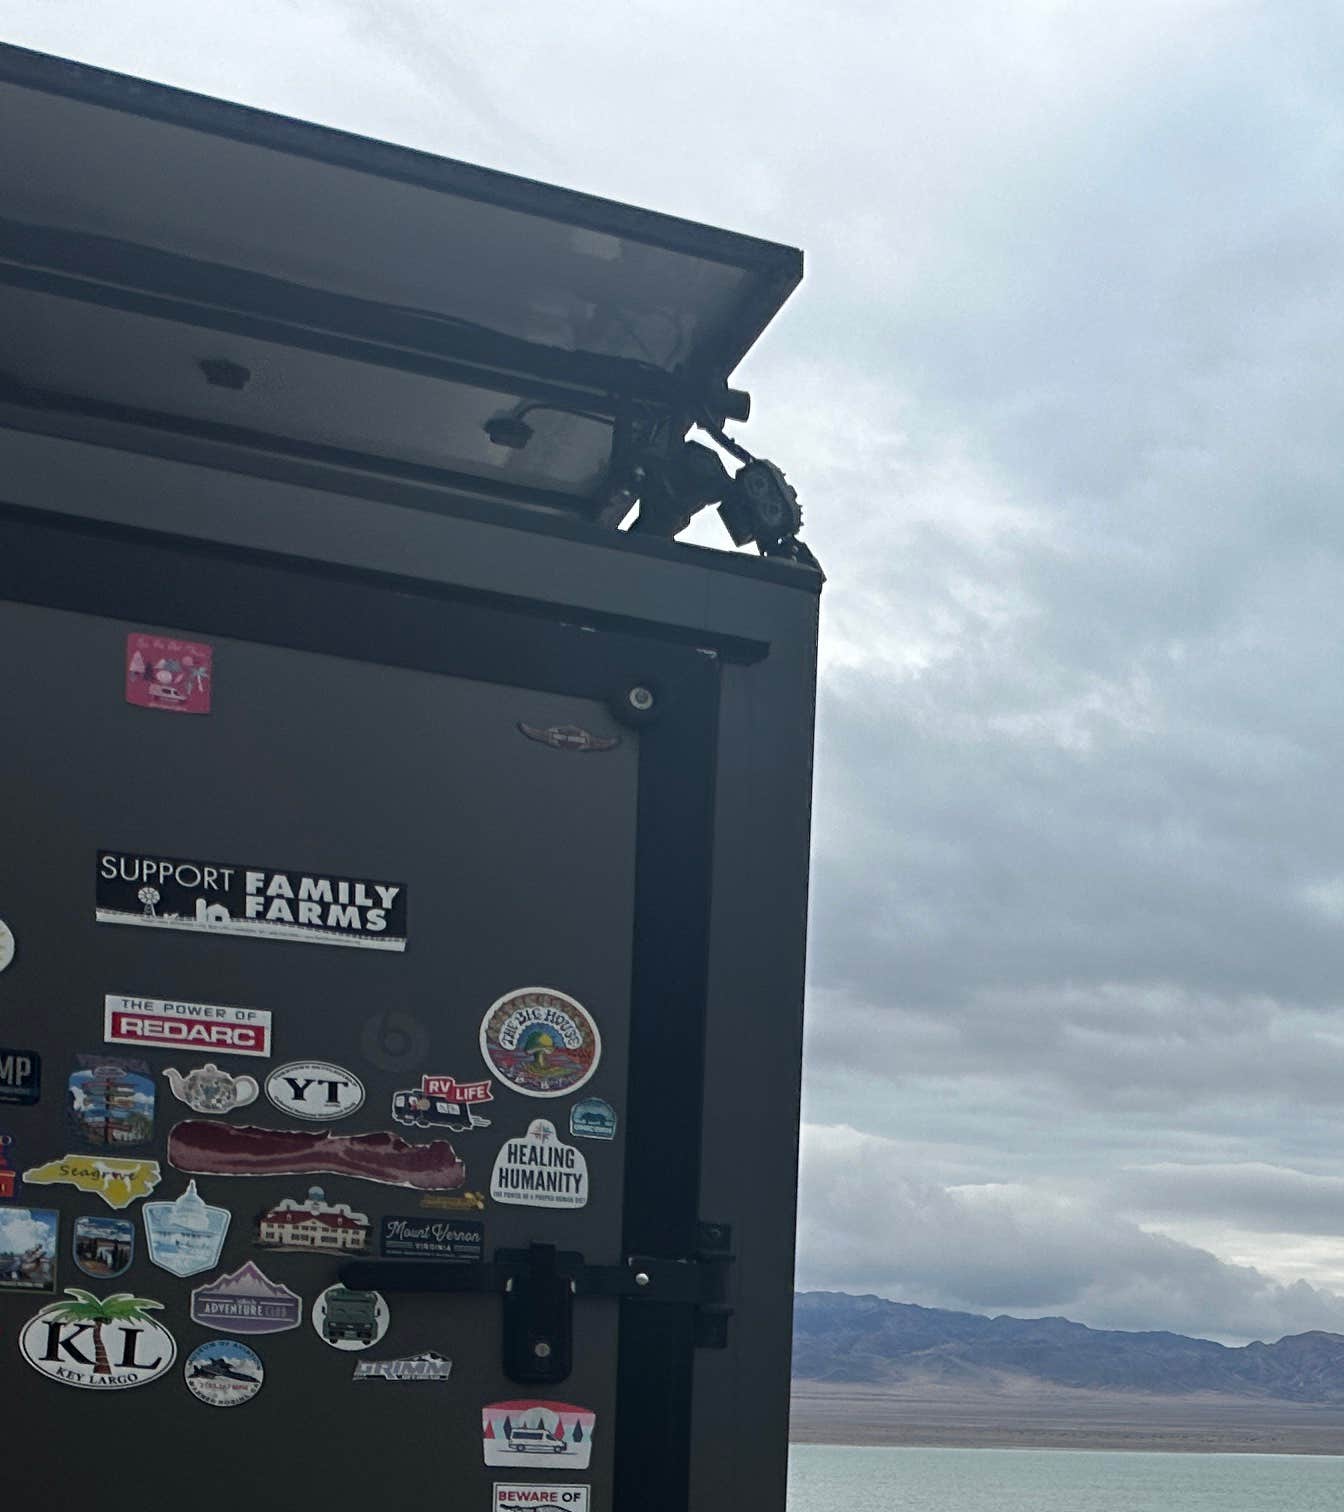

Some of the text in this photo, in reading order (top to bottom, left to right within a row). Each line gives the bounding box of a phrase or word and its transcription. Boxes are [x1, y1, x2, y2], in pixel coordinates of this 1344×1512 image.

[101, 855, 400, 909] SUPPORT FAMILY
[245, 895, 388, 932] FARMS
[121, 999, 257, 1021] THE POWER OF
[120, 1017, 256, 1046] REDARC
[501, 1008, 580, 1048] THE BIG HOUSE
[282, 1077, 349, 1104] YT
[428, 1080, 485, 1100] RV LIFE
[507, 1143, 575, 1169] HEALING
[499, 1167, 583, 1194] HUMANITY
[385, 1221, 481, 1242] Mount Vernon
[204, 1303, 263, 1316] ADVENTURE
[56, 1365, 138, 1386] KEY LARGO
[498, 1490, 581, 1503] BEWARE OF
